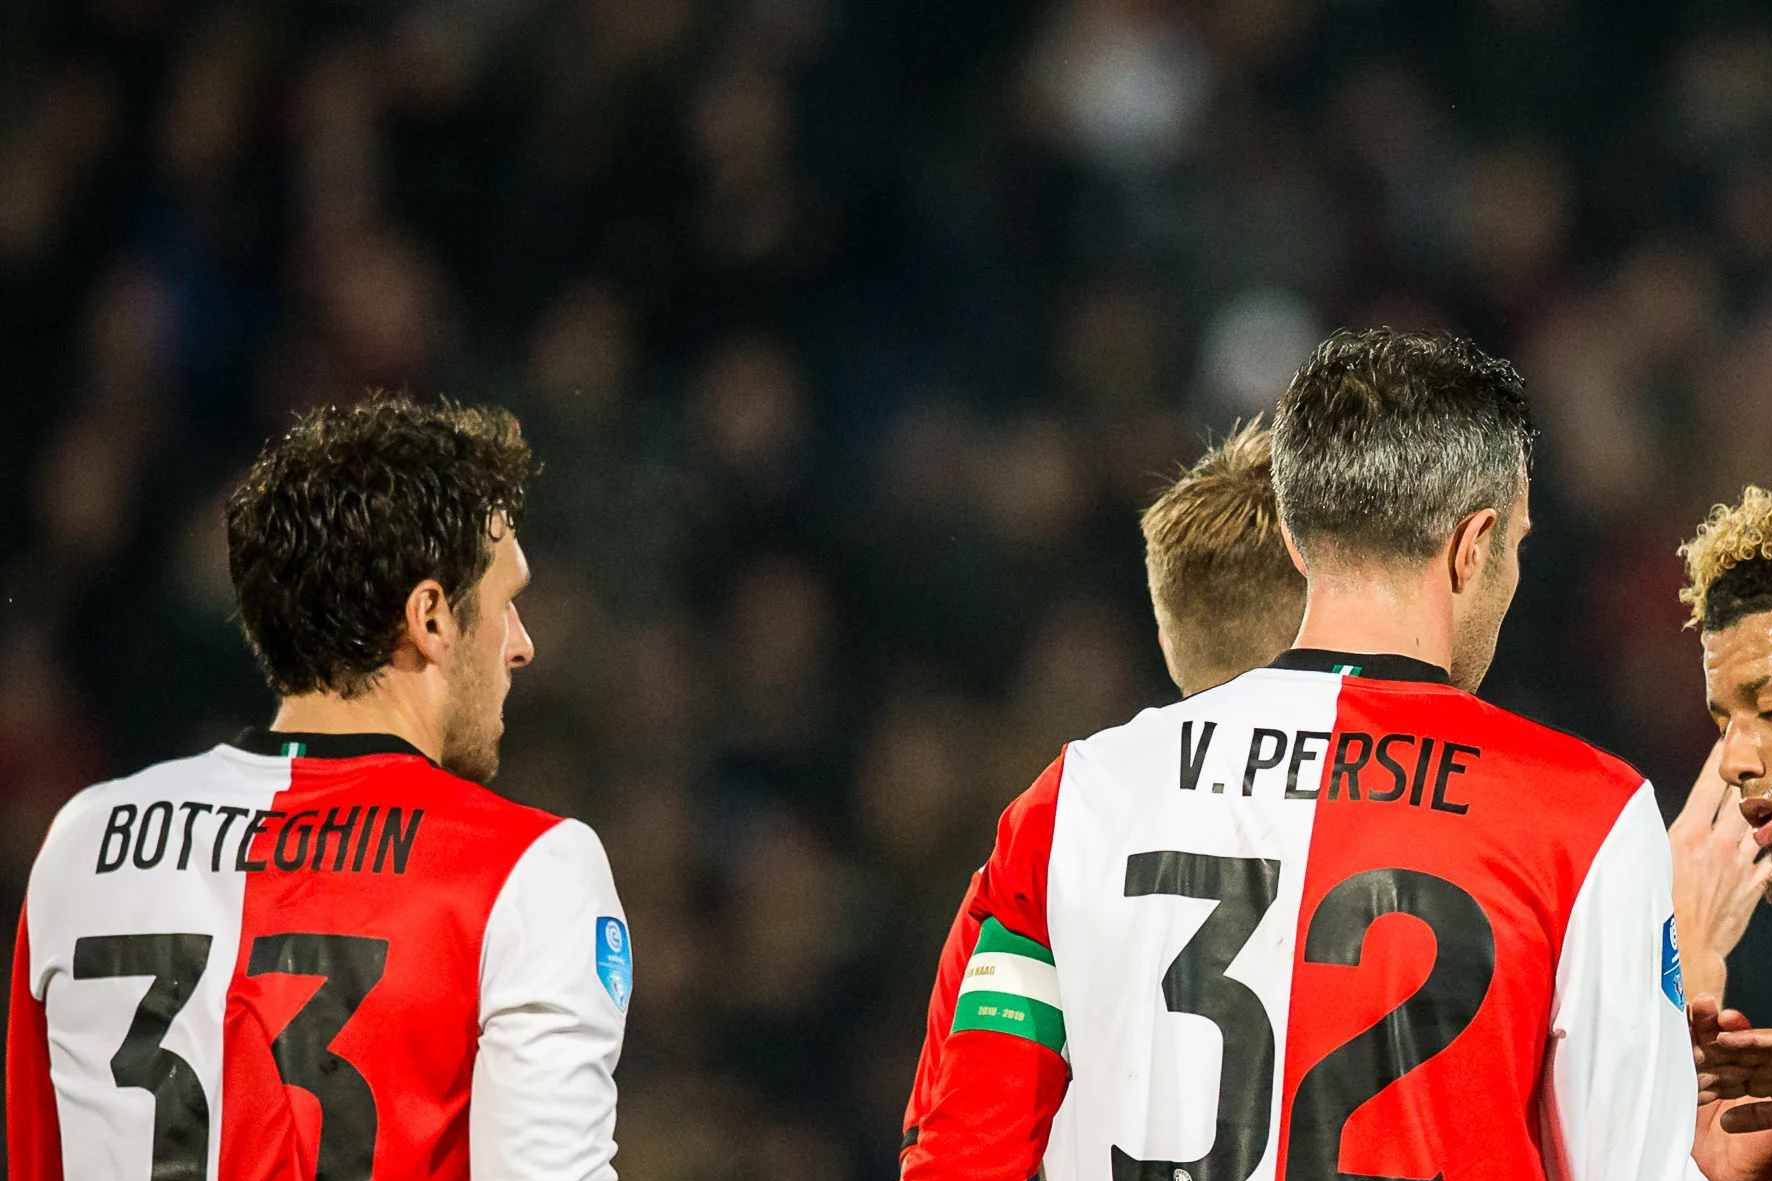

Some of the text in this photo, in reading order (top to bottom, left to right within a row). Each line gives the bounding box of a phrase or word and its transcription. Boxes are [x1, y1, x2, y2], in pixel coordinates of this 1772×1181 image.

[1179, 720, 1481, 815] V. PERSIE
[96, 800, 425, 875] BOTTEGHIN
